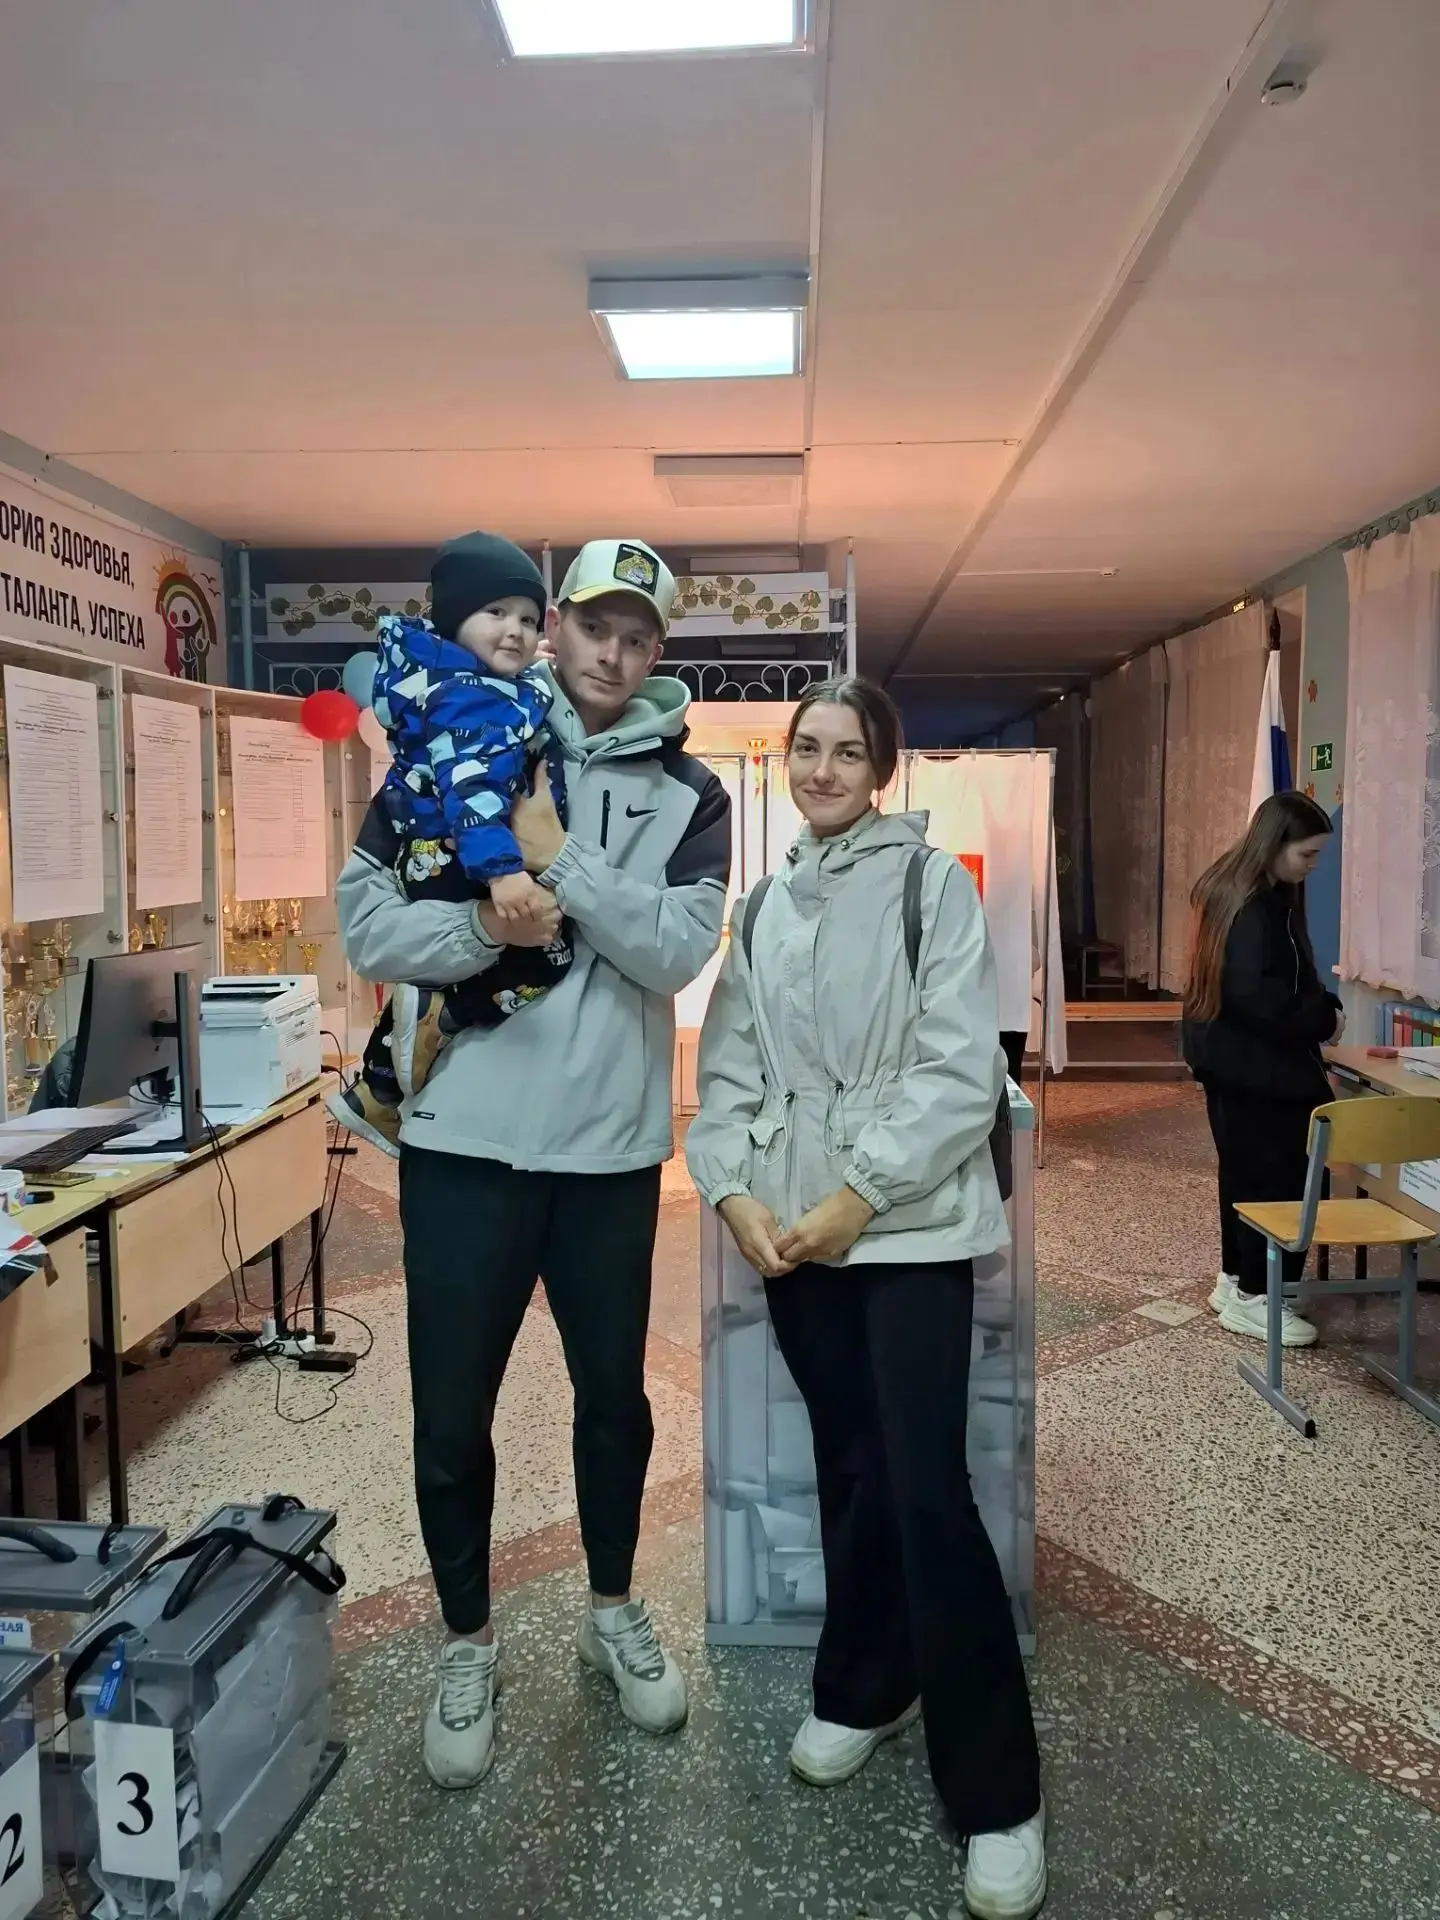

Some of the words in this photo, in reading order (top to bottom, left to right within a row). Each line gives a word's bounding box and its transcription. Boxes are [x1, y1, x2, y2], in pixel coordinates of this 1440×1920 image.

[50, 522, 135, 591] ЗДОРОВЬЯ,
[0, 572, 85, 637] ТАЛАНТА,
[88, 600, 146, 649] УСПЕХА
[117, 1772, 153, 1836] 3
[0, 1813, 25, 1887] 2
